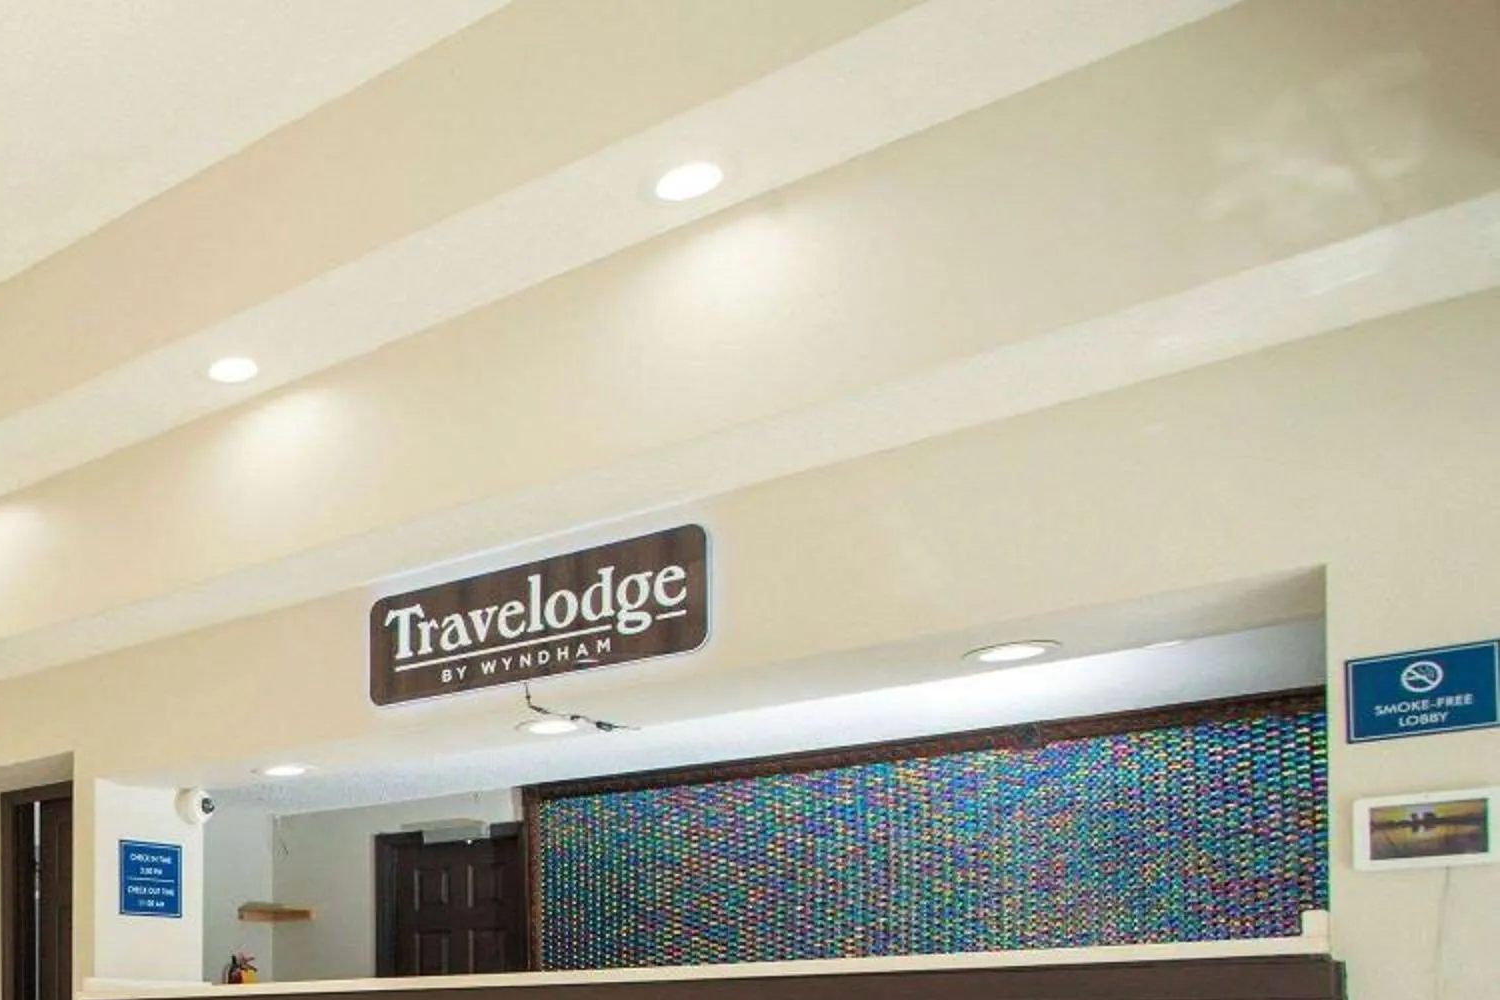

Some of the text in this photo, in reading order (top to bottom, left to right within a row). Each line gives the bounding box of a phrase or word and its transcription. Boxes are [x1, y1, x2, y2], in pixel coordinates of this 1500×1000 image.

[385, 564, 688, 661] Travelodge
[441, 637, 612, 683] BY WYNDHAM
[1374, 693, 1474, 716] SMOKE-FREE
[1398, 711, 1449, 727] LOBBY
